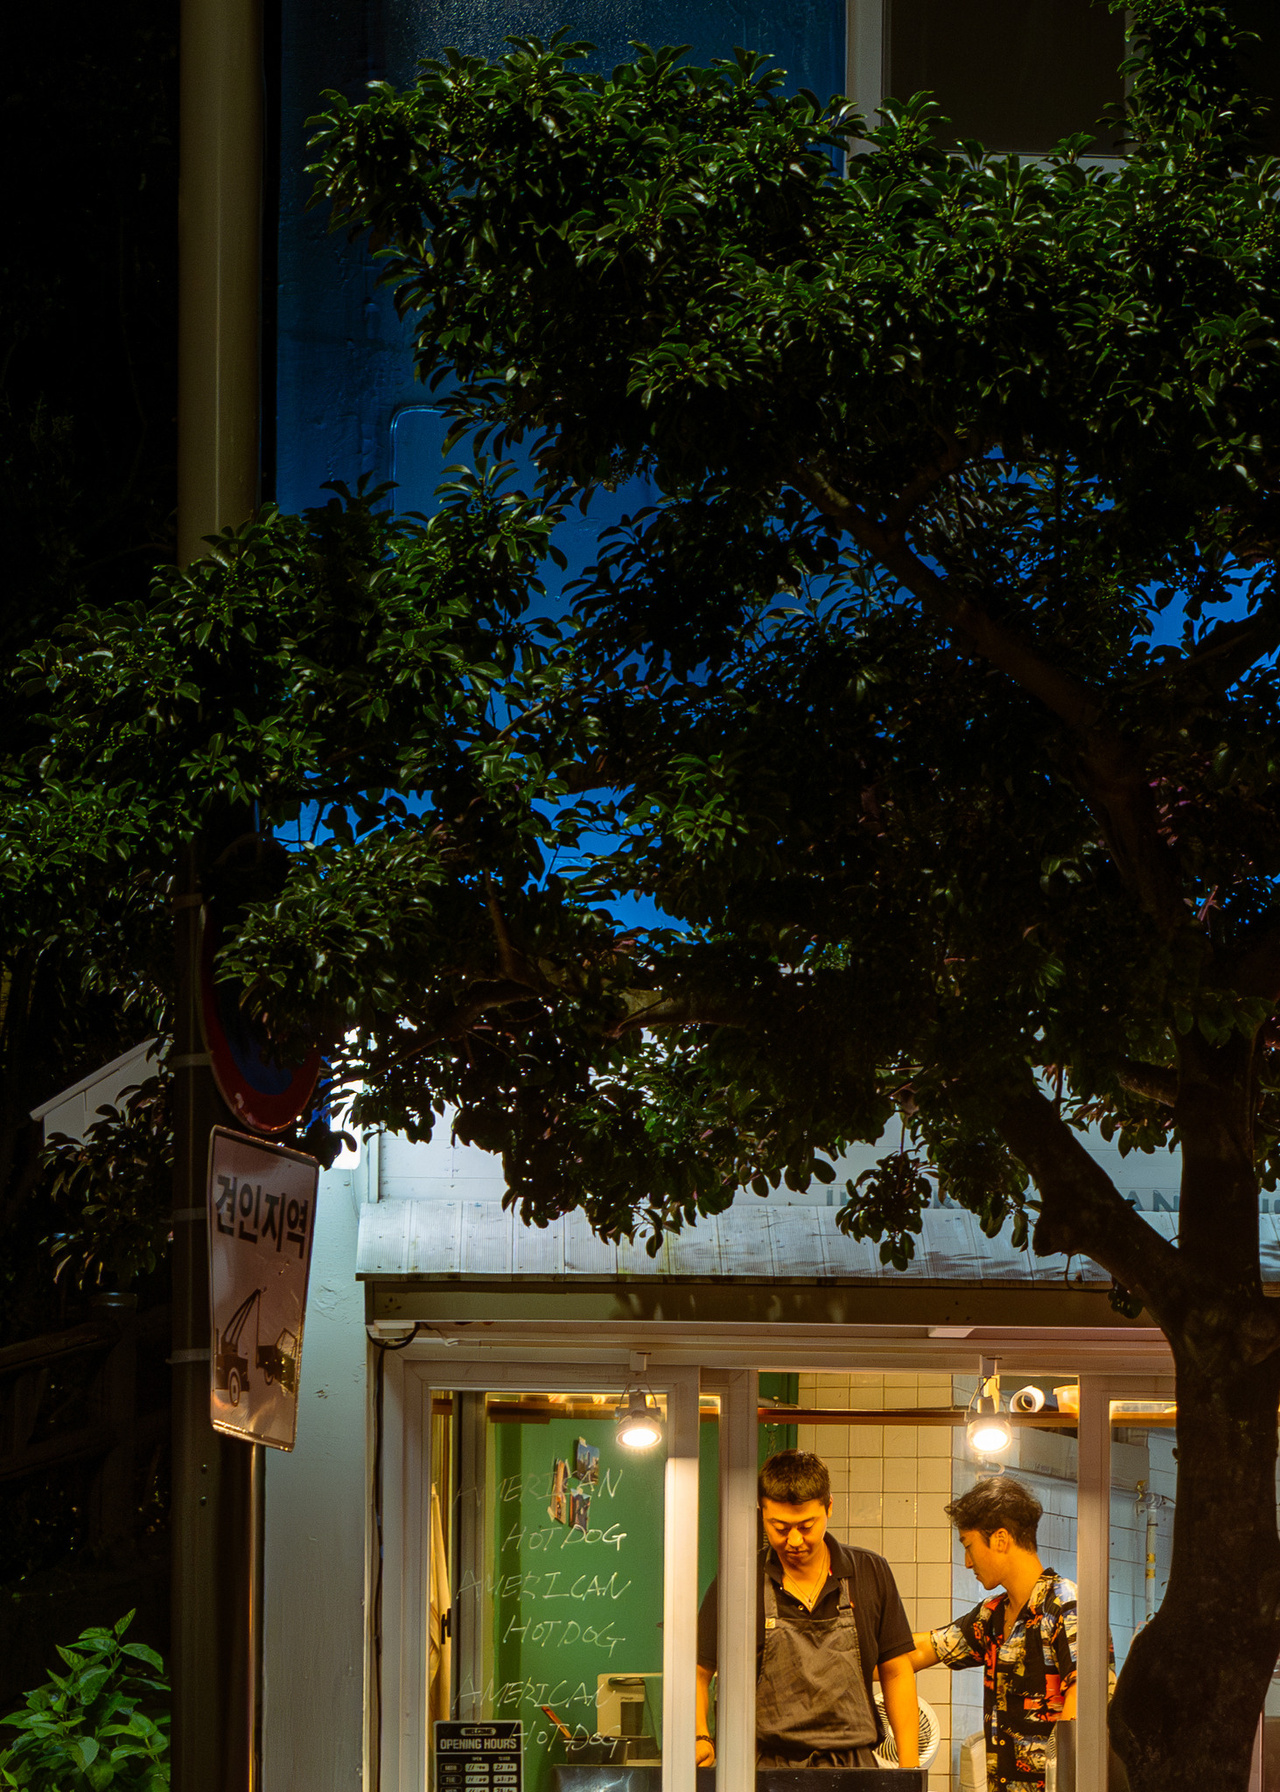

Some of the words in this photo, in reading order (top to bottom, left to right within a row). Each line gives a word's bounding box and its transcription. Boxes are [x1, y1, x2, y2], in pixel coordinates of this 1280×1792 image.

[216, 1175, 308, 1260] 견인지역
[440, 1738, 482, 1750] OPENING
[484, 1738, 517, 1750] HOURS
